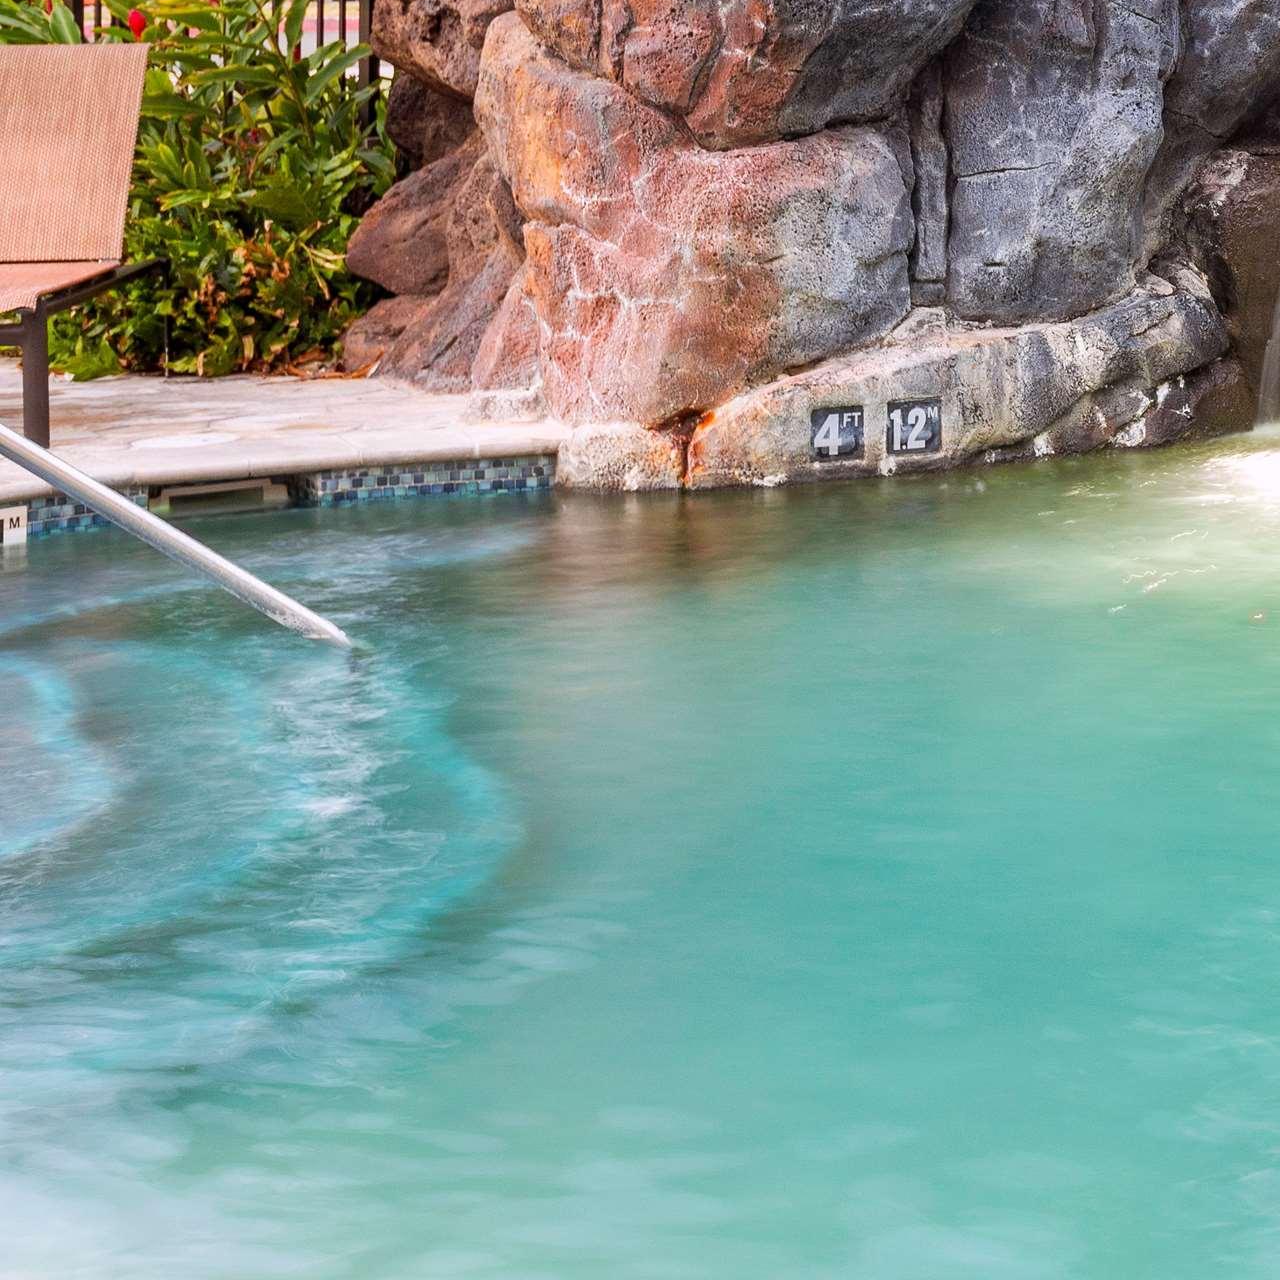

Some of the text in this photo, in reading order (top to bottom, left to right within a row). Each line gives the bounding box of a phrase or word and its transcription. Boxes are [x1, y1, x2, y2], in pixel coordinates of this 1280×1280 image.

[813, 411, 862, 456] 4 FT
[889, 406, 938, 451] 1.2 M
[9, 516, 20, 529] M
